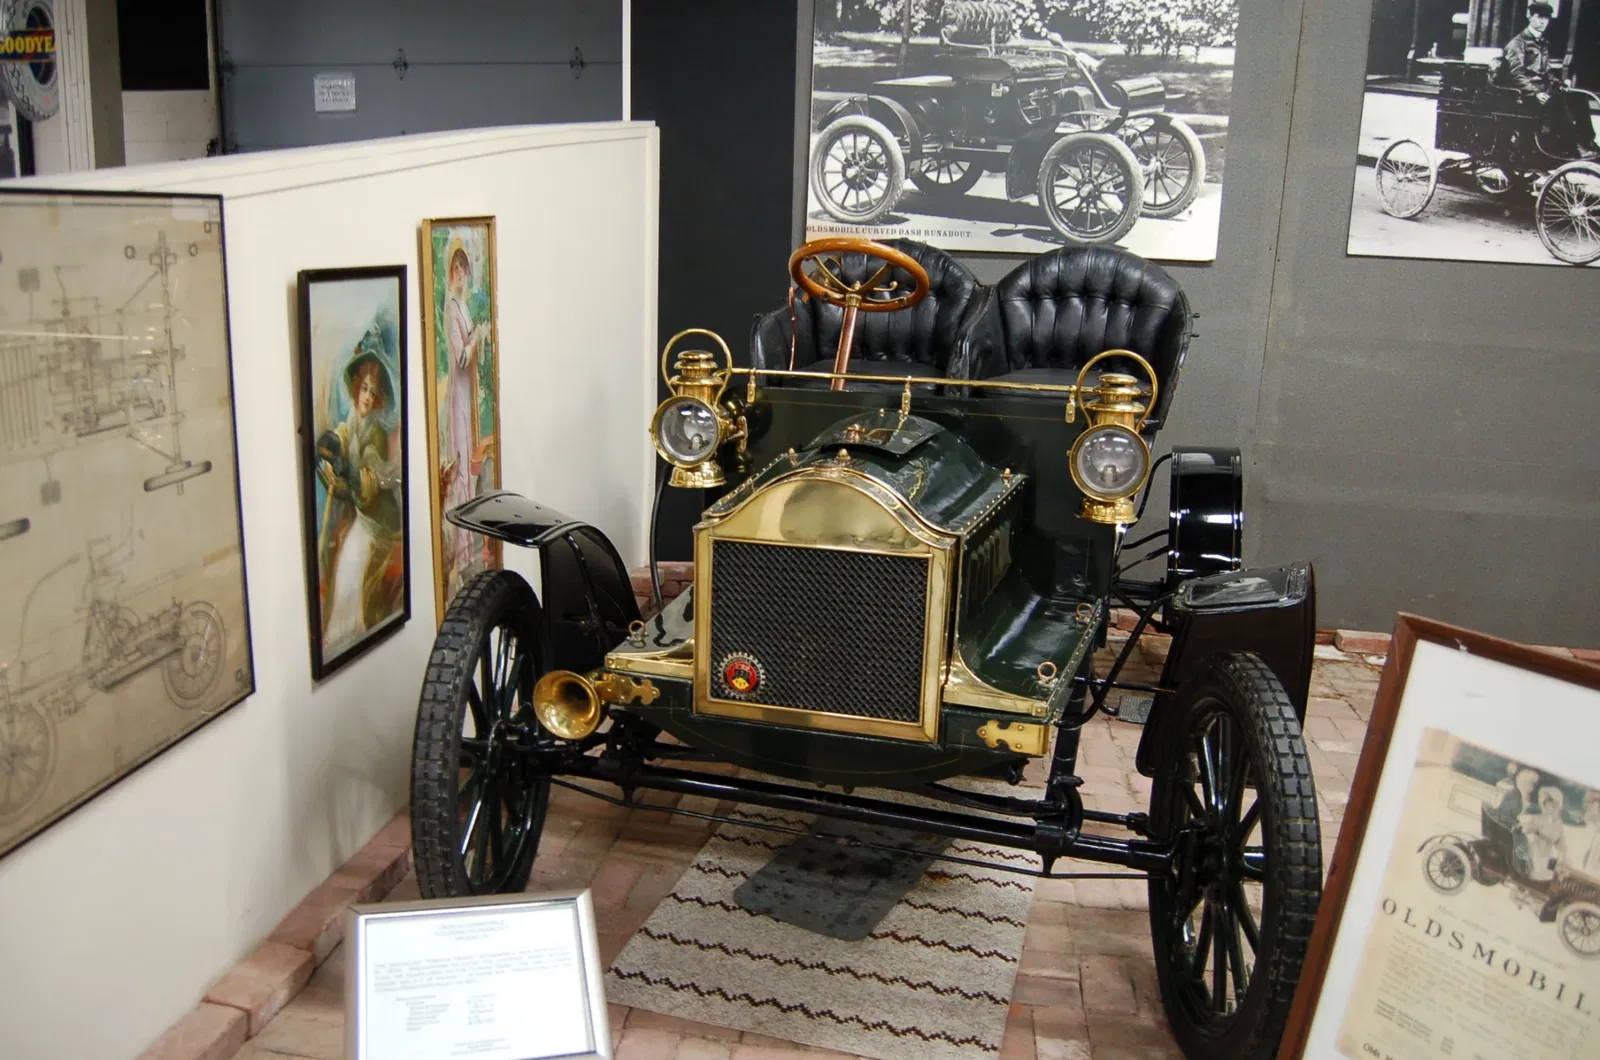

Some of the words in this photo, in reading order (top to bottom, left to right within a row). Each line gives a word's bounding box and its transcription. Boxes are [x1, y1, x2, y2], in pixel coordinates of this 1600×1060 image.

[0, 36, 56, 54] GOODYE
[806, 226, 861, 234] OLDSMOBILE
[1382, 898, 1600, 1021] OLDSMOBIL
